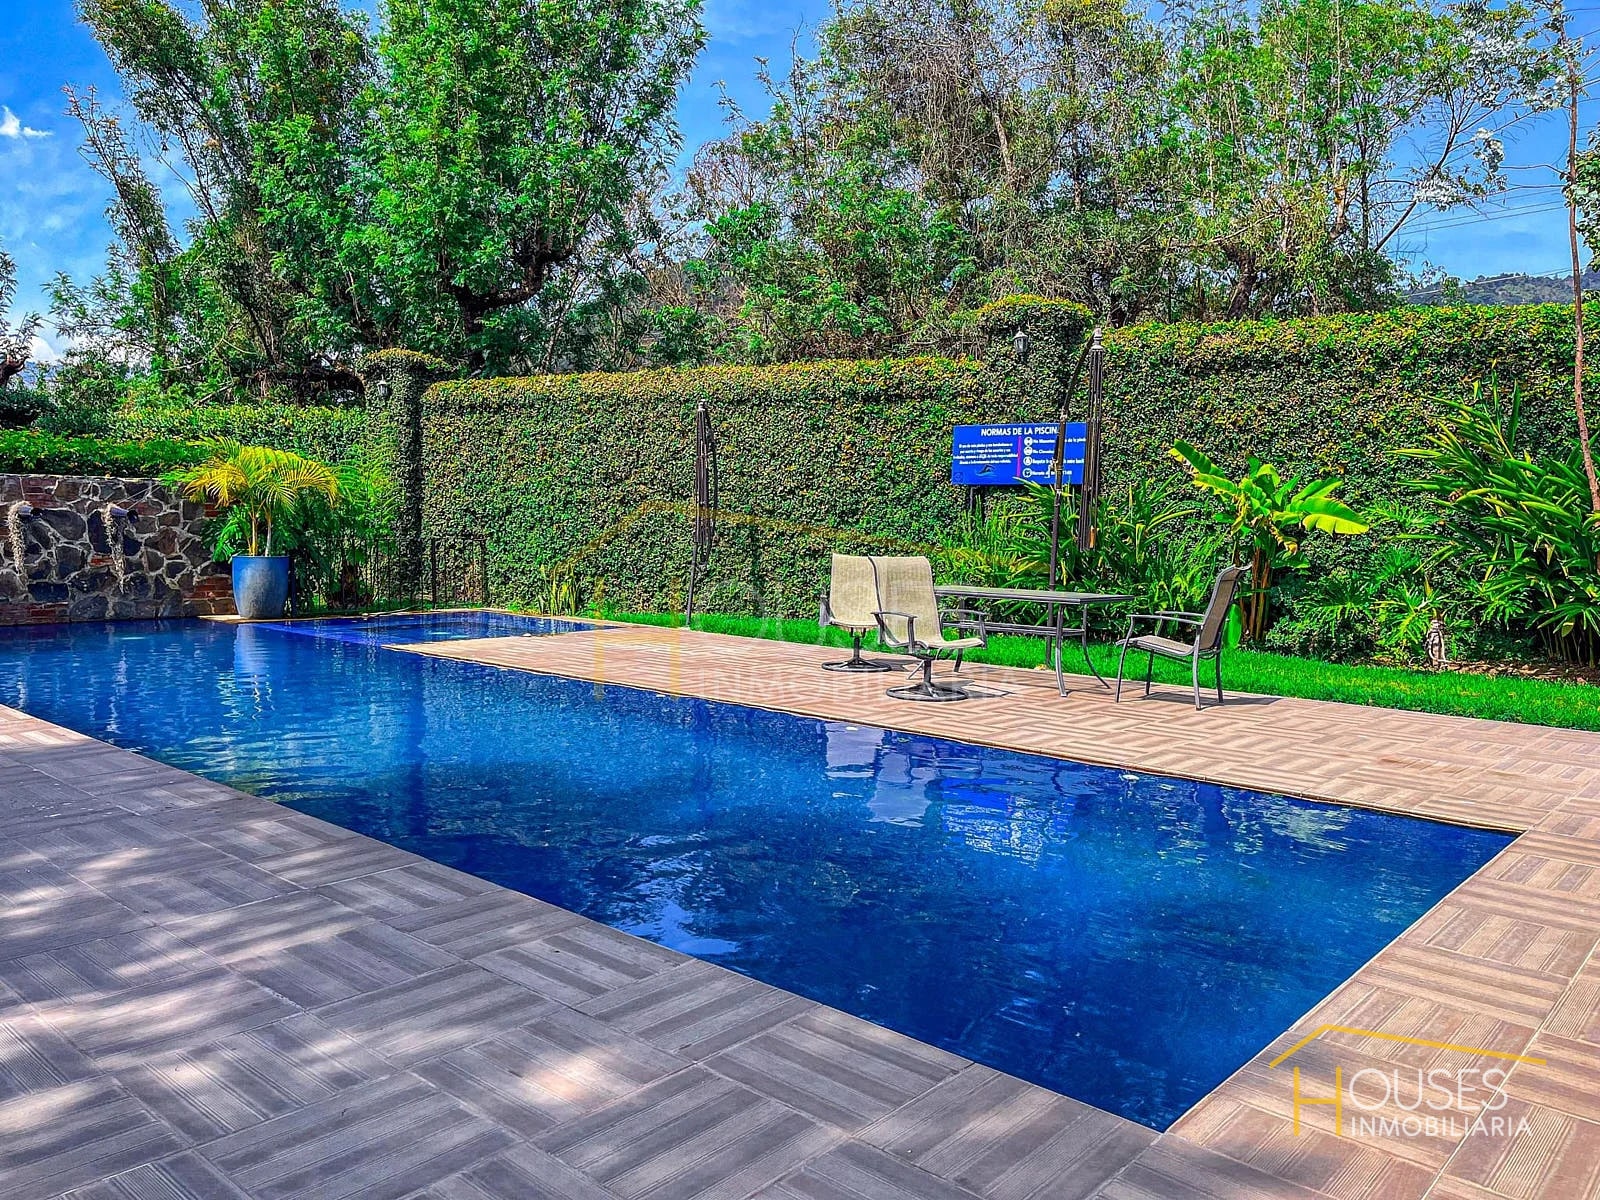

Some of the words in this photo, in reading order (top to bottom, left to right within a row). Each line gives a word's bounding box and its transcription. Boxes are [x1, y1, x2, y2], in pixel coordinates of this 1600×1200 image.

[981, 427, 1011, 436] NORMAS
[1012, 427, 1022, 436] DE
[1024, 427, 1033, 435] LA
[1034, 426, 1060, 435] PISCIN
